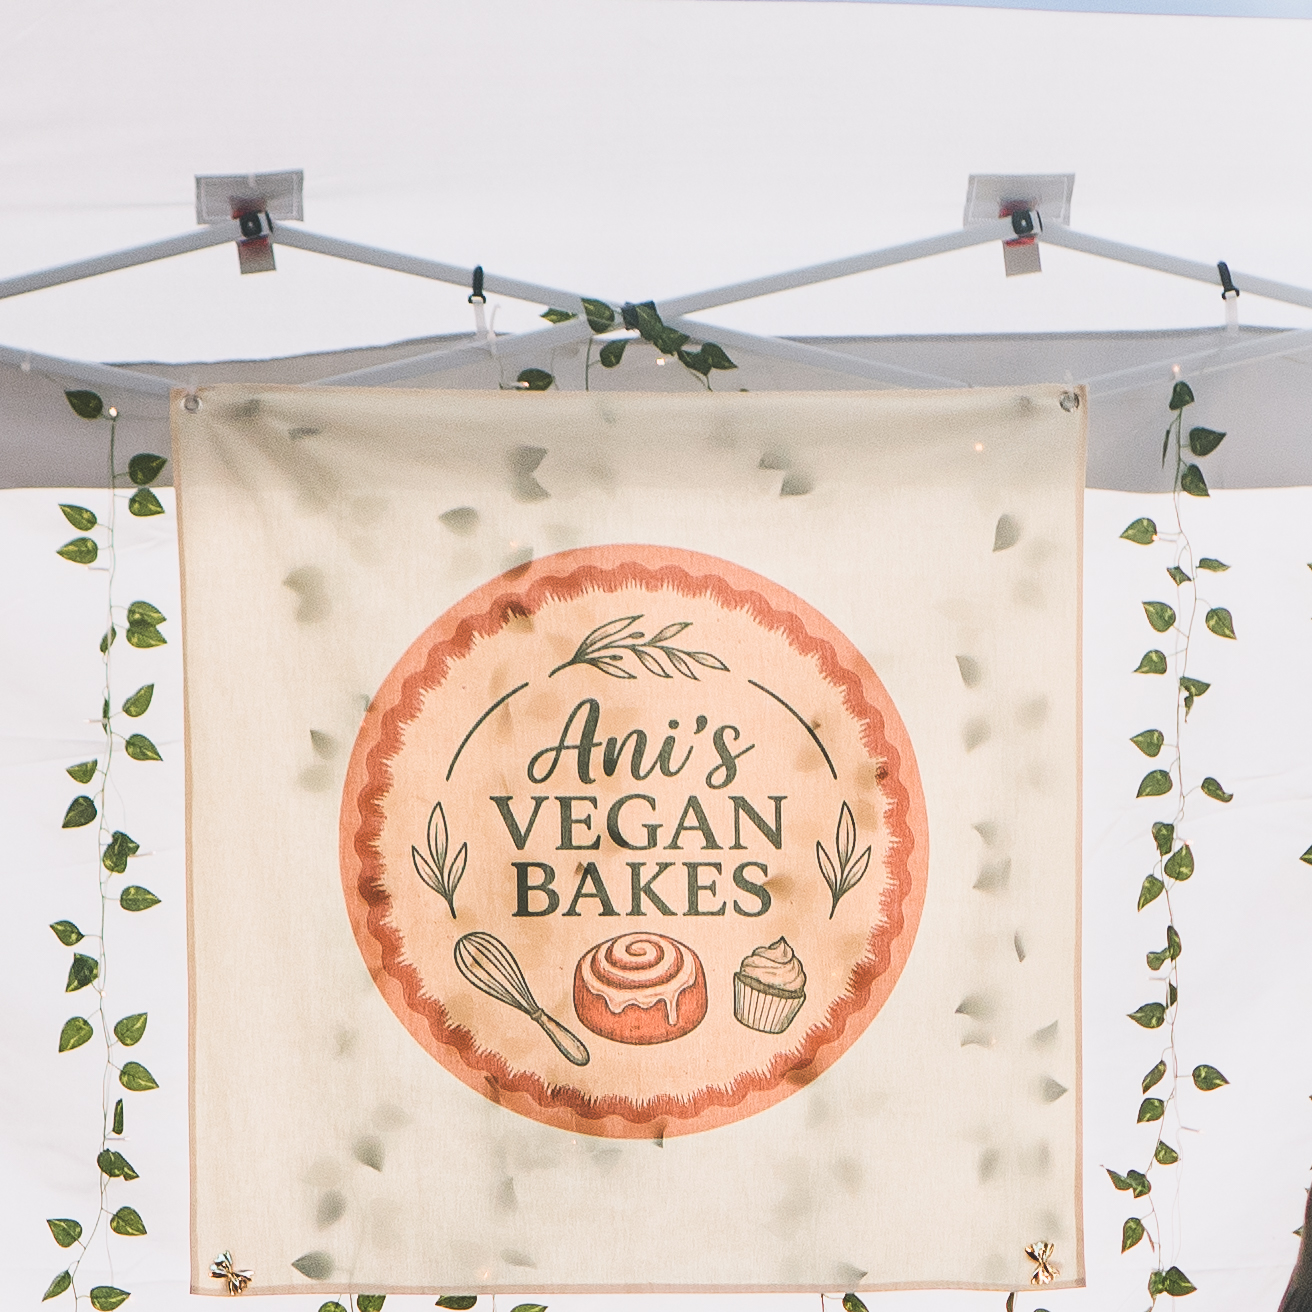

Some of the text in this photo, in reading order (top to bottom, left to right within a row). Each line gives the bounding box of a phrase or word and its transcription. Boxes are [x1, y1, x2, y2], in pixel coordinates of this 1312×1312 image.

[527, 697, 755, 790] Ani's
[490, 793, 788, 853] VEGAN
[511, 860, 773, 918] BAKES
